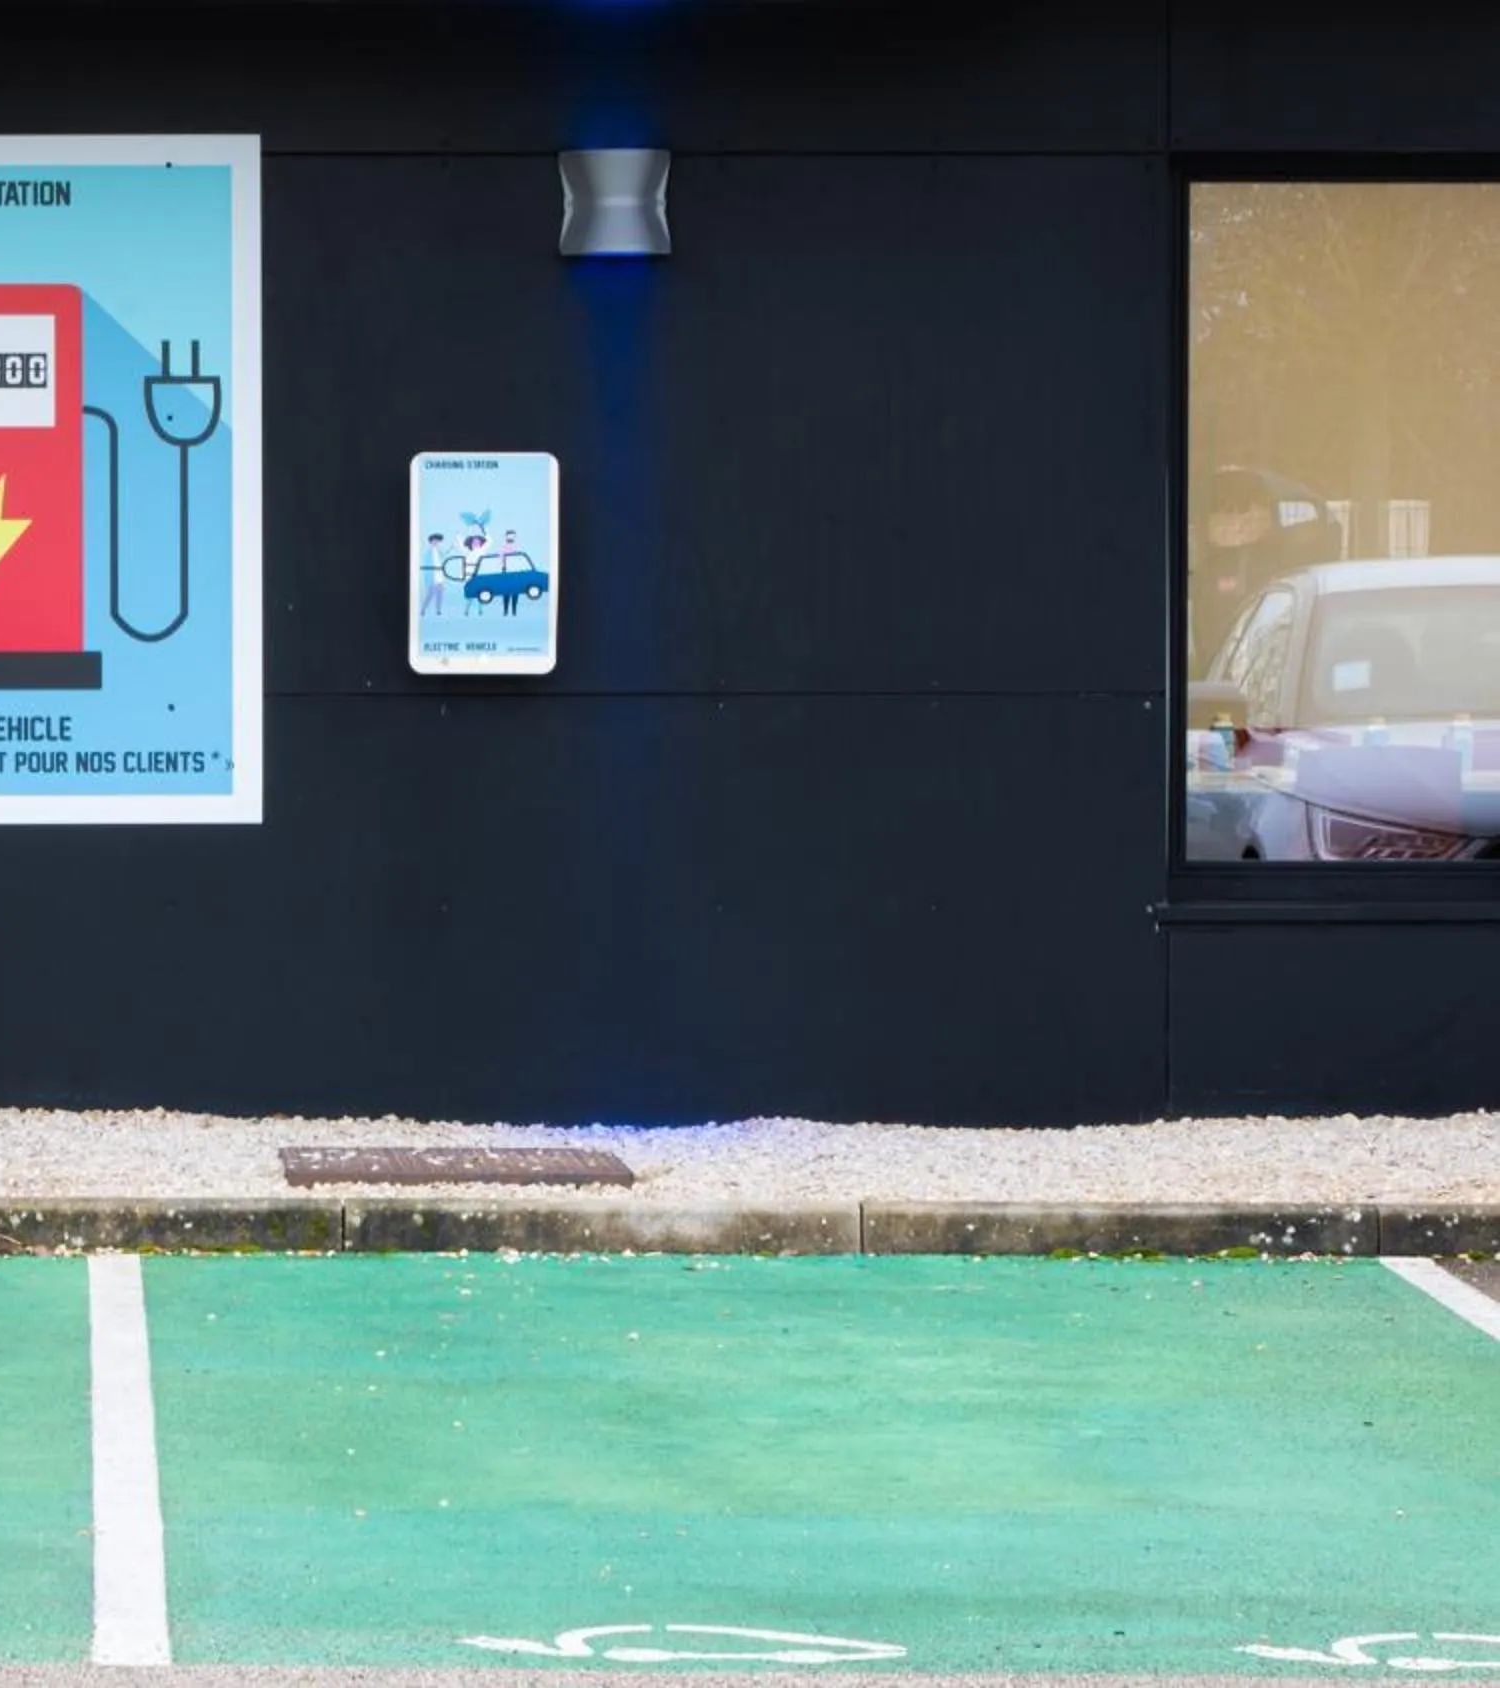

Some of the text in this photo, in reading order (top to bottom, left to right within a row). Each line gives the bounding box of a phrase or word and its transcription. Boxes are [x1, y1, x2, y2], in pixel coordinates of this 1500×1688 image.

[14, 752, 68, 773] POUR
[75, 752, 116, 773] NOS
[123, 751, 205, 773] CLIENTS
